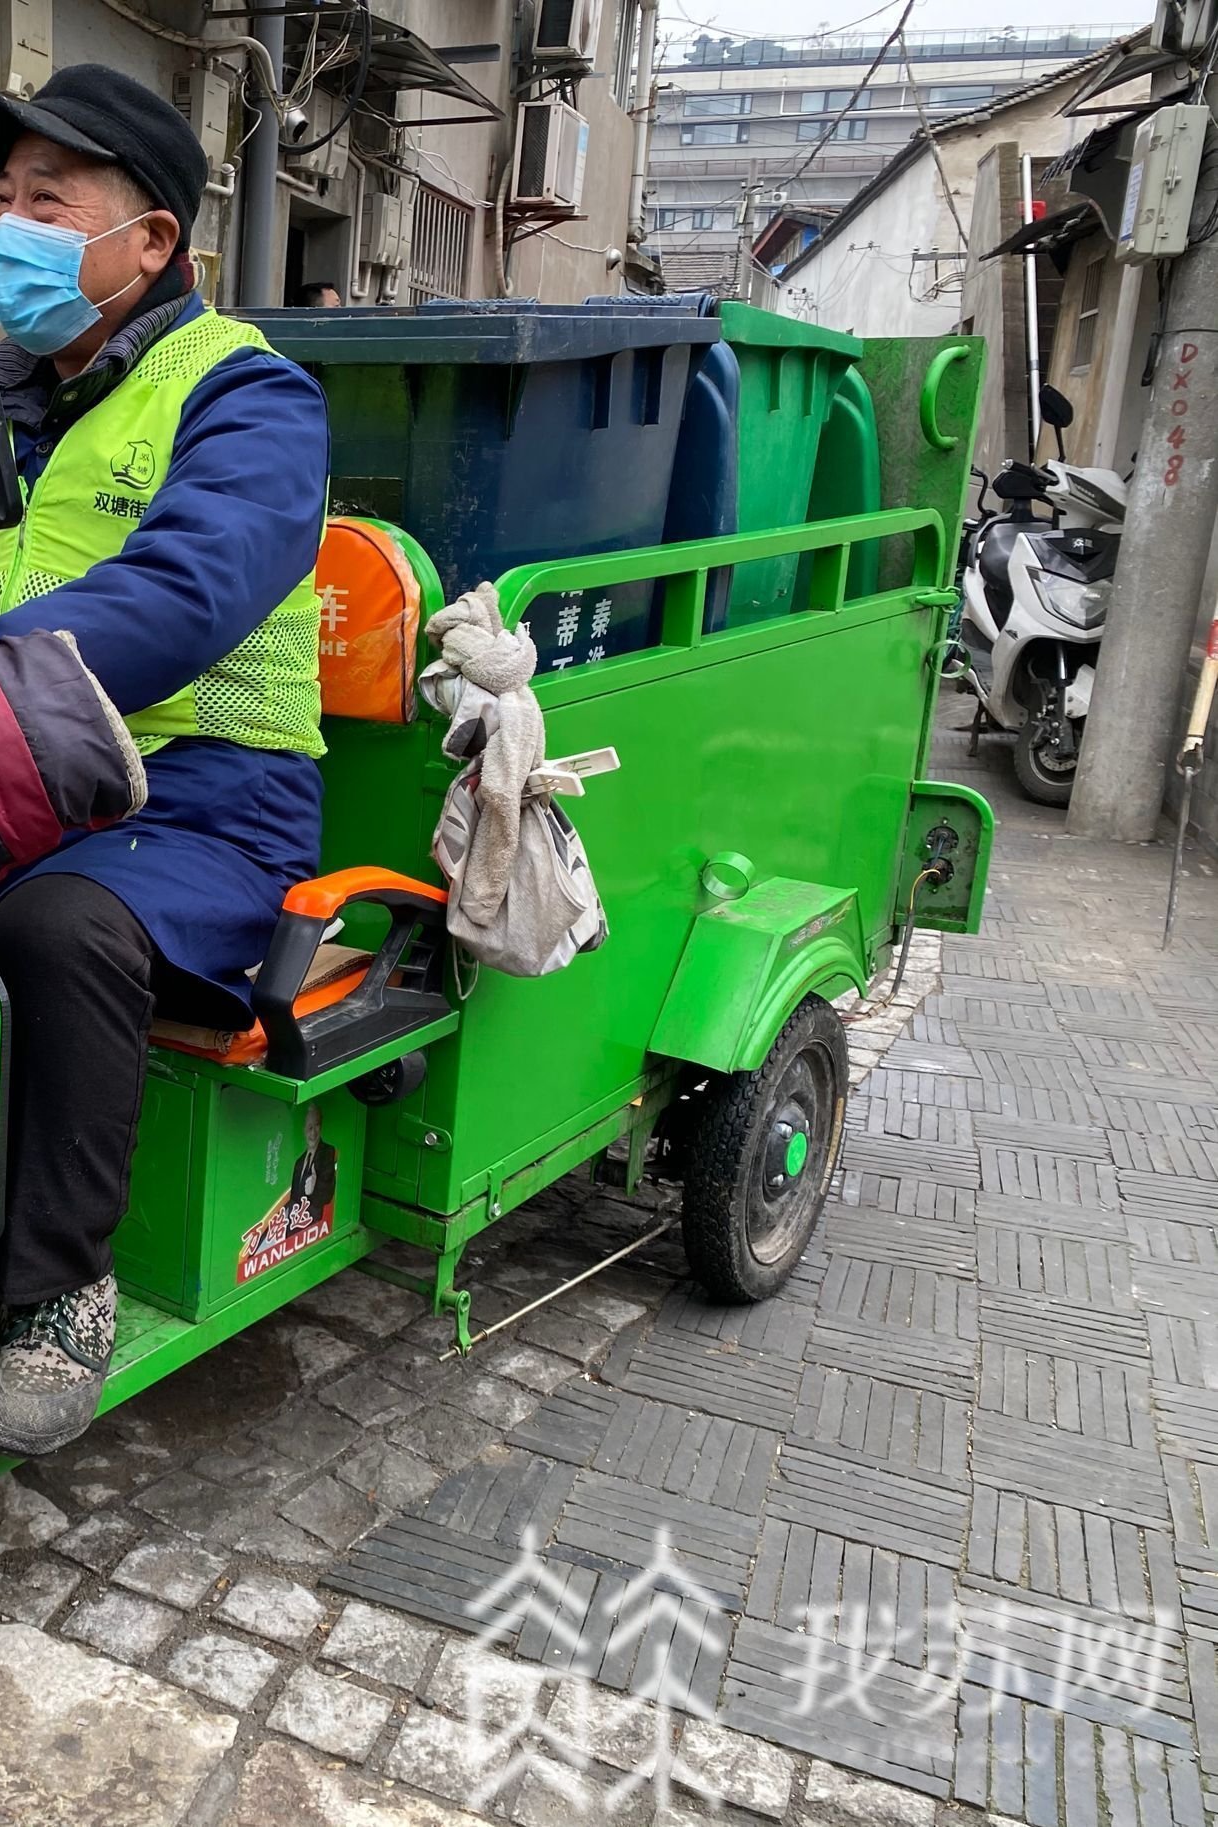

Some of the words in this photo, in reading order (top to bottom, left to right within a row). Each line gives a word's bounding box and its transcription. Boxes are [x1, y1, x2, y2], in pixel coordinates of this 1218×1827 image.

[1164, 342, 1199, 487] DX048
[94, 491, 149, 519] 双塘街
[316, 584, 350, 632] 车
[320, 639, 349, 657] HE
[240, 1196, 314, 1258] 万路达
[243, 1221, 330, 1279] WANLUDA
